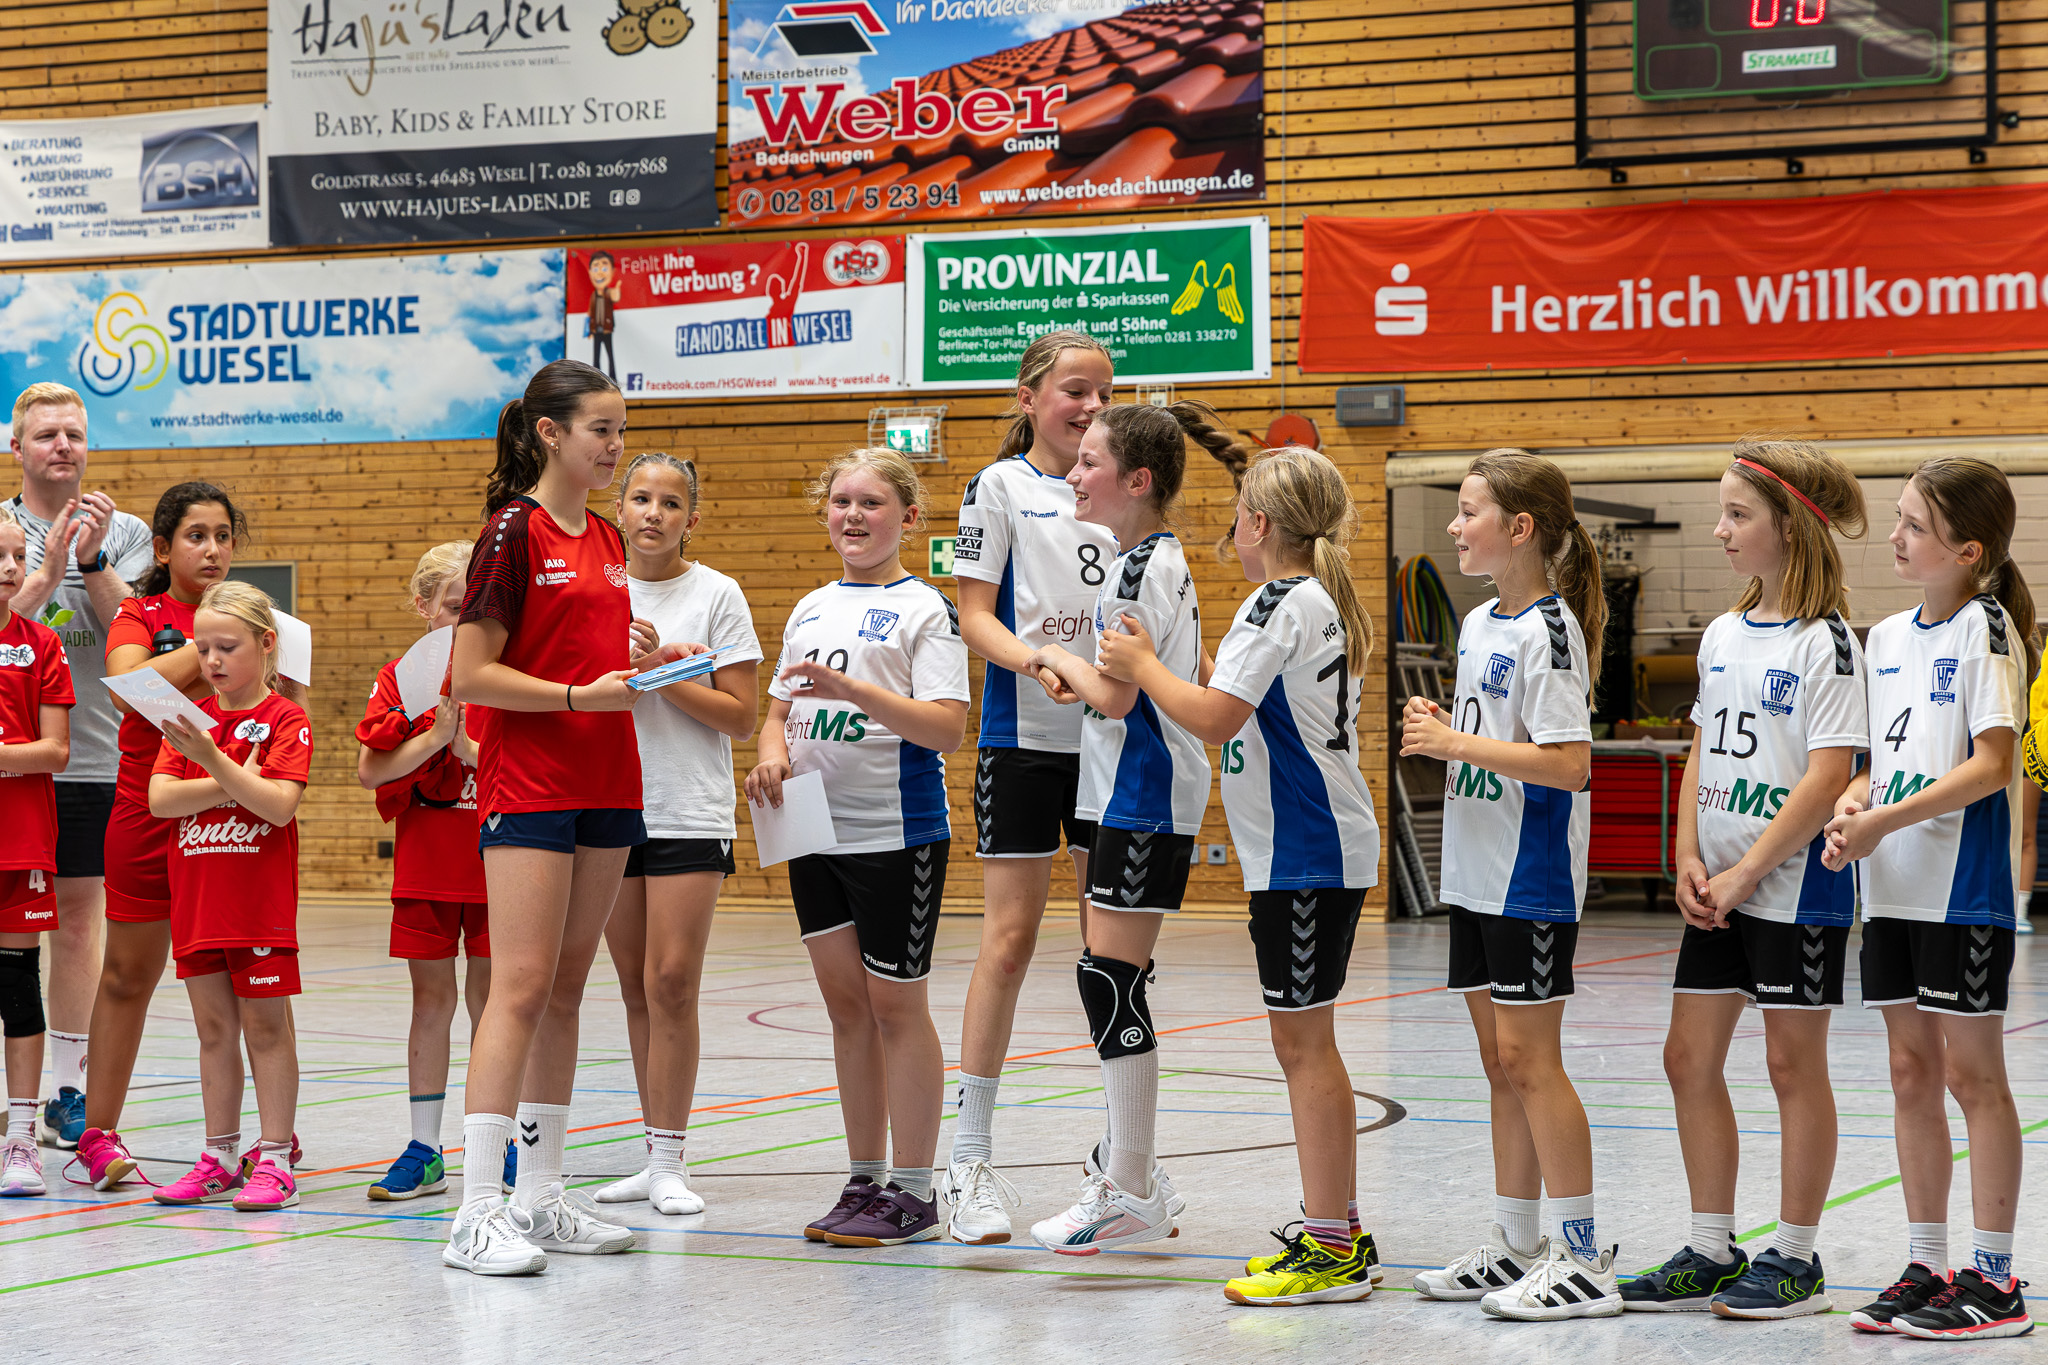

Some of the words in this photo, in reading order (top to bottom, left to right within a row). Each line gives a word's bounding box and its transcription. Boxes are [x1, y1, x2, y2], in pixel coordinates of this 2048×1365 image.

[896, 0, 926, 24] Ihr
[1746, 48, 1831, 69] STRAMATEL
[742, 64, 848, 82] Meisterbetrieb
[314, 110, 383, 138] BABY,
[391, 108, 450, 134] KIDS
[457, 110, 474, 131] &
[482, 102, 577, 130] FAMILY
[583, 97, 667, 124] STORE
[743, 76, 1067, 147] Weber
[11, 137, 82, 151] BERATUNG
[1003, 135, 1060, 153] GmbH
[21, 153, 82, 167] PLANUNG
[755, 146, 875, 167] Bedachungen
[28, 168, 113, 183] AUSFÜHRUNG
[155, 159, 243, 201] BSH
[311, 171, 414, 191] GOLDSTRASSE
[429, 166, 476, 187] 46483
[479, 164, 527, 183] WESEL
[538, 162, 555, 180] T.
[557, 162, 592, 181] 0281
[595, 156, 668, 180] 20677868
[37, 185, 89, 199] SERVICE
[770, 190, 801, 214] 02
[804, 188, 836, 212] 81
[844, 186, 857, 212] /
[864, 186, 881, 209] 5
[886, 184, 920, 207] 23
[926, 181, 960, 206] 94
[980, 170, 1254, 204] www.weberbedachungen.de
[43, 202, 107, 216] WARTUNG
[340, 192, 591, 221] WWW.HAJUES-LADEN.DE
[620, 256, 661, 275] Fehlt
[664, 253, 695, 270] Ihre
[833, 250, 879, 272] HSG
[938, 248, 1169, 290] PROVINZIAL
[649, 269, 745, 296] Werbung
[748, 263, 761, 286] ?
[939, 299, 960, 313] Die
[962, 296, 1050, 314] Versicherung
[1052, 294, 1073, 309] der
[1091, 292, 1169, 309] Sparkassen
[1491, 275, 1721, 333] Herzlich
[1735, 266, 2048, 323] Willkomm
[168, 294, 420, 342] STADTWERKE
[938, 325, 1015, 338] Geschäftsstelle
[1017, 318, 1087, 337] Egerlandt
[1090, 318, 1118, 332] und
[1122, 316, 1167, 332] Söhne
[676, 321, 767, 356] HANDBALL
[772, 317, 789, 346] IN
[793, 312, 851, 342] WESEL
[938, 337, 1027, 351] Berliner-Tor-Platz
[1124, 332, 1163, 345] Telefon
[1164, 331, 1191, 343] 0281
[1196, 329, 1237, 342] 338270
[178, 344, 311, 385] WESEL
[646, 377, 777, 392] facebook.com/HSGWesel
[788, 374, 891, 389] www.hsg-wesel.de
[150, 409, 344, 429] www.stadtwerke-wesel.de
[960, 526, 980, 537] WE
[1077, 543, 1106, 586] 8
[1322, 622, 1338, 642] HG
[1491, 661, 1510, 686] HG
[1937, 667, 1957, 690] HG
[1770, 677, 1792, 702] HG
[1709, 707, 1758, 759] 15
[1884, 707, 1912, 752] 4
[183, 842, 260, 857] Backmanufaktur
[29, 869, 47, 893] 4
[25, 910, 54, 920] Kempa
[870, 955, 899, 971] hummel
[249, 975, 280, 986] Kempa
[1495, 981, 1526, 992] hummel
[1761, 983, 1793, 993] hummel
[1924, 986, 1959, 1001] hummel
